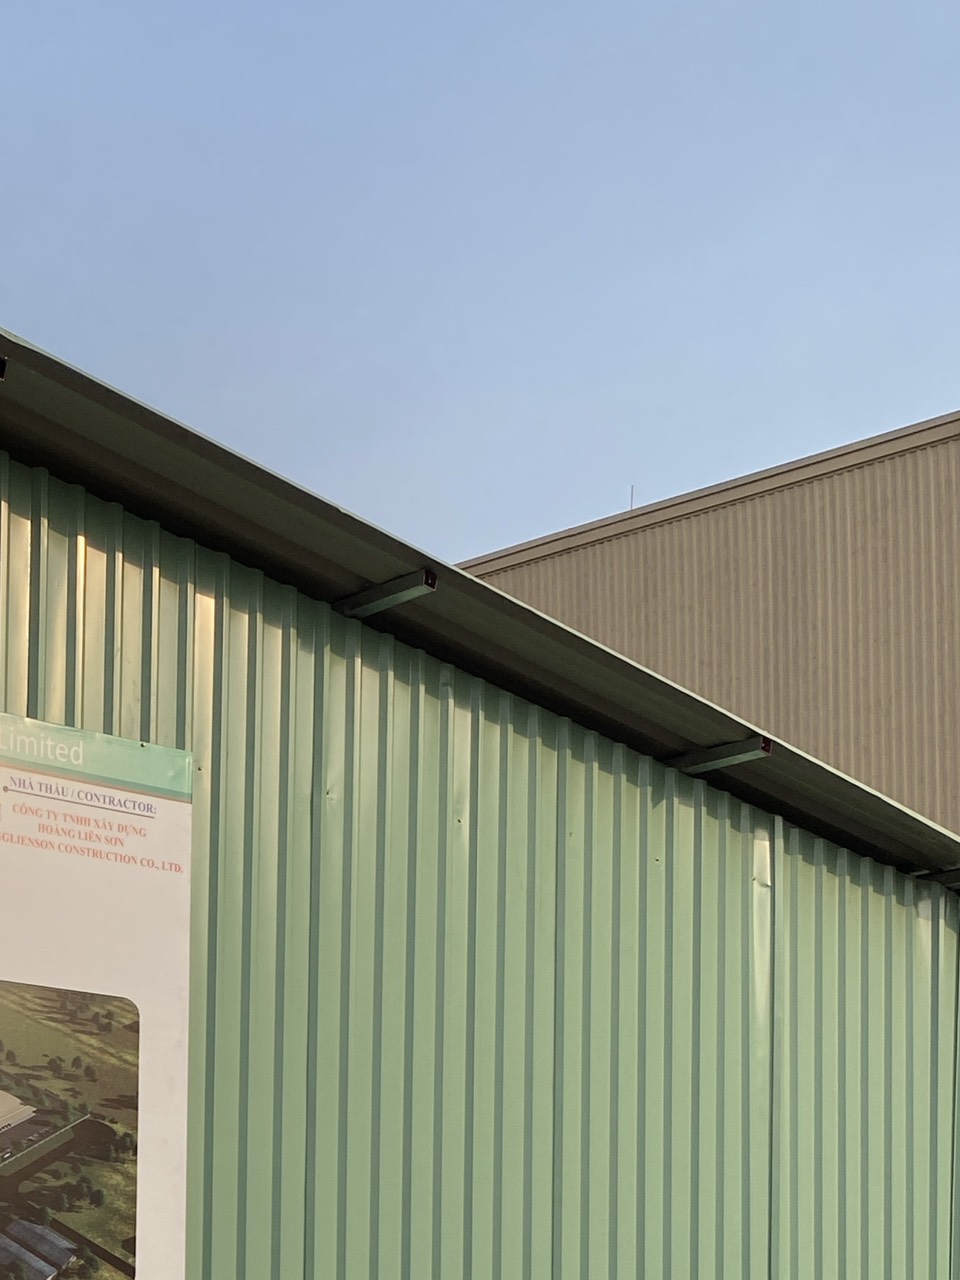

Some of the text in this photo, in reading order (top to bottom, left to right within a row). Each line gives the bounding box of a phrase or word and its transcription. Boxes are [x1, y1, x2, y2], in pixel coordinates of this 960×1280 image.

[77, 789, 157, 814] CONTRACTOR:
[12, 803, 43, 818] CÔNG
[45, 810, 60, 821] TY
[63, 813, 91, 827] TNHH
[58, 843, 137, 865] CONSTRUCTION
[162, 860, 184, 873] LTD.
